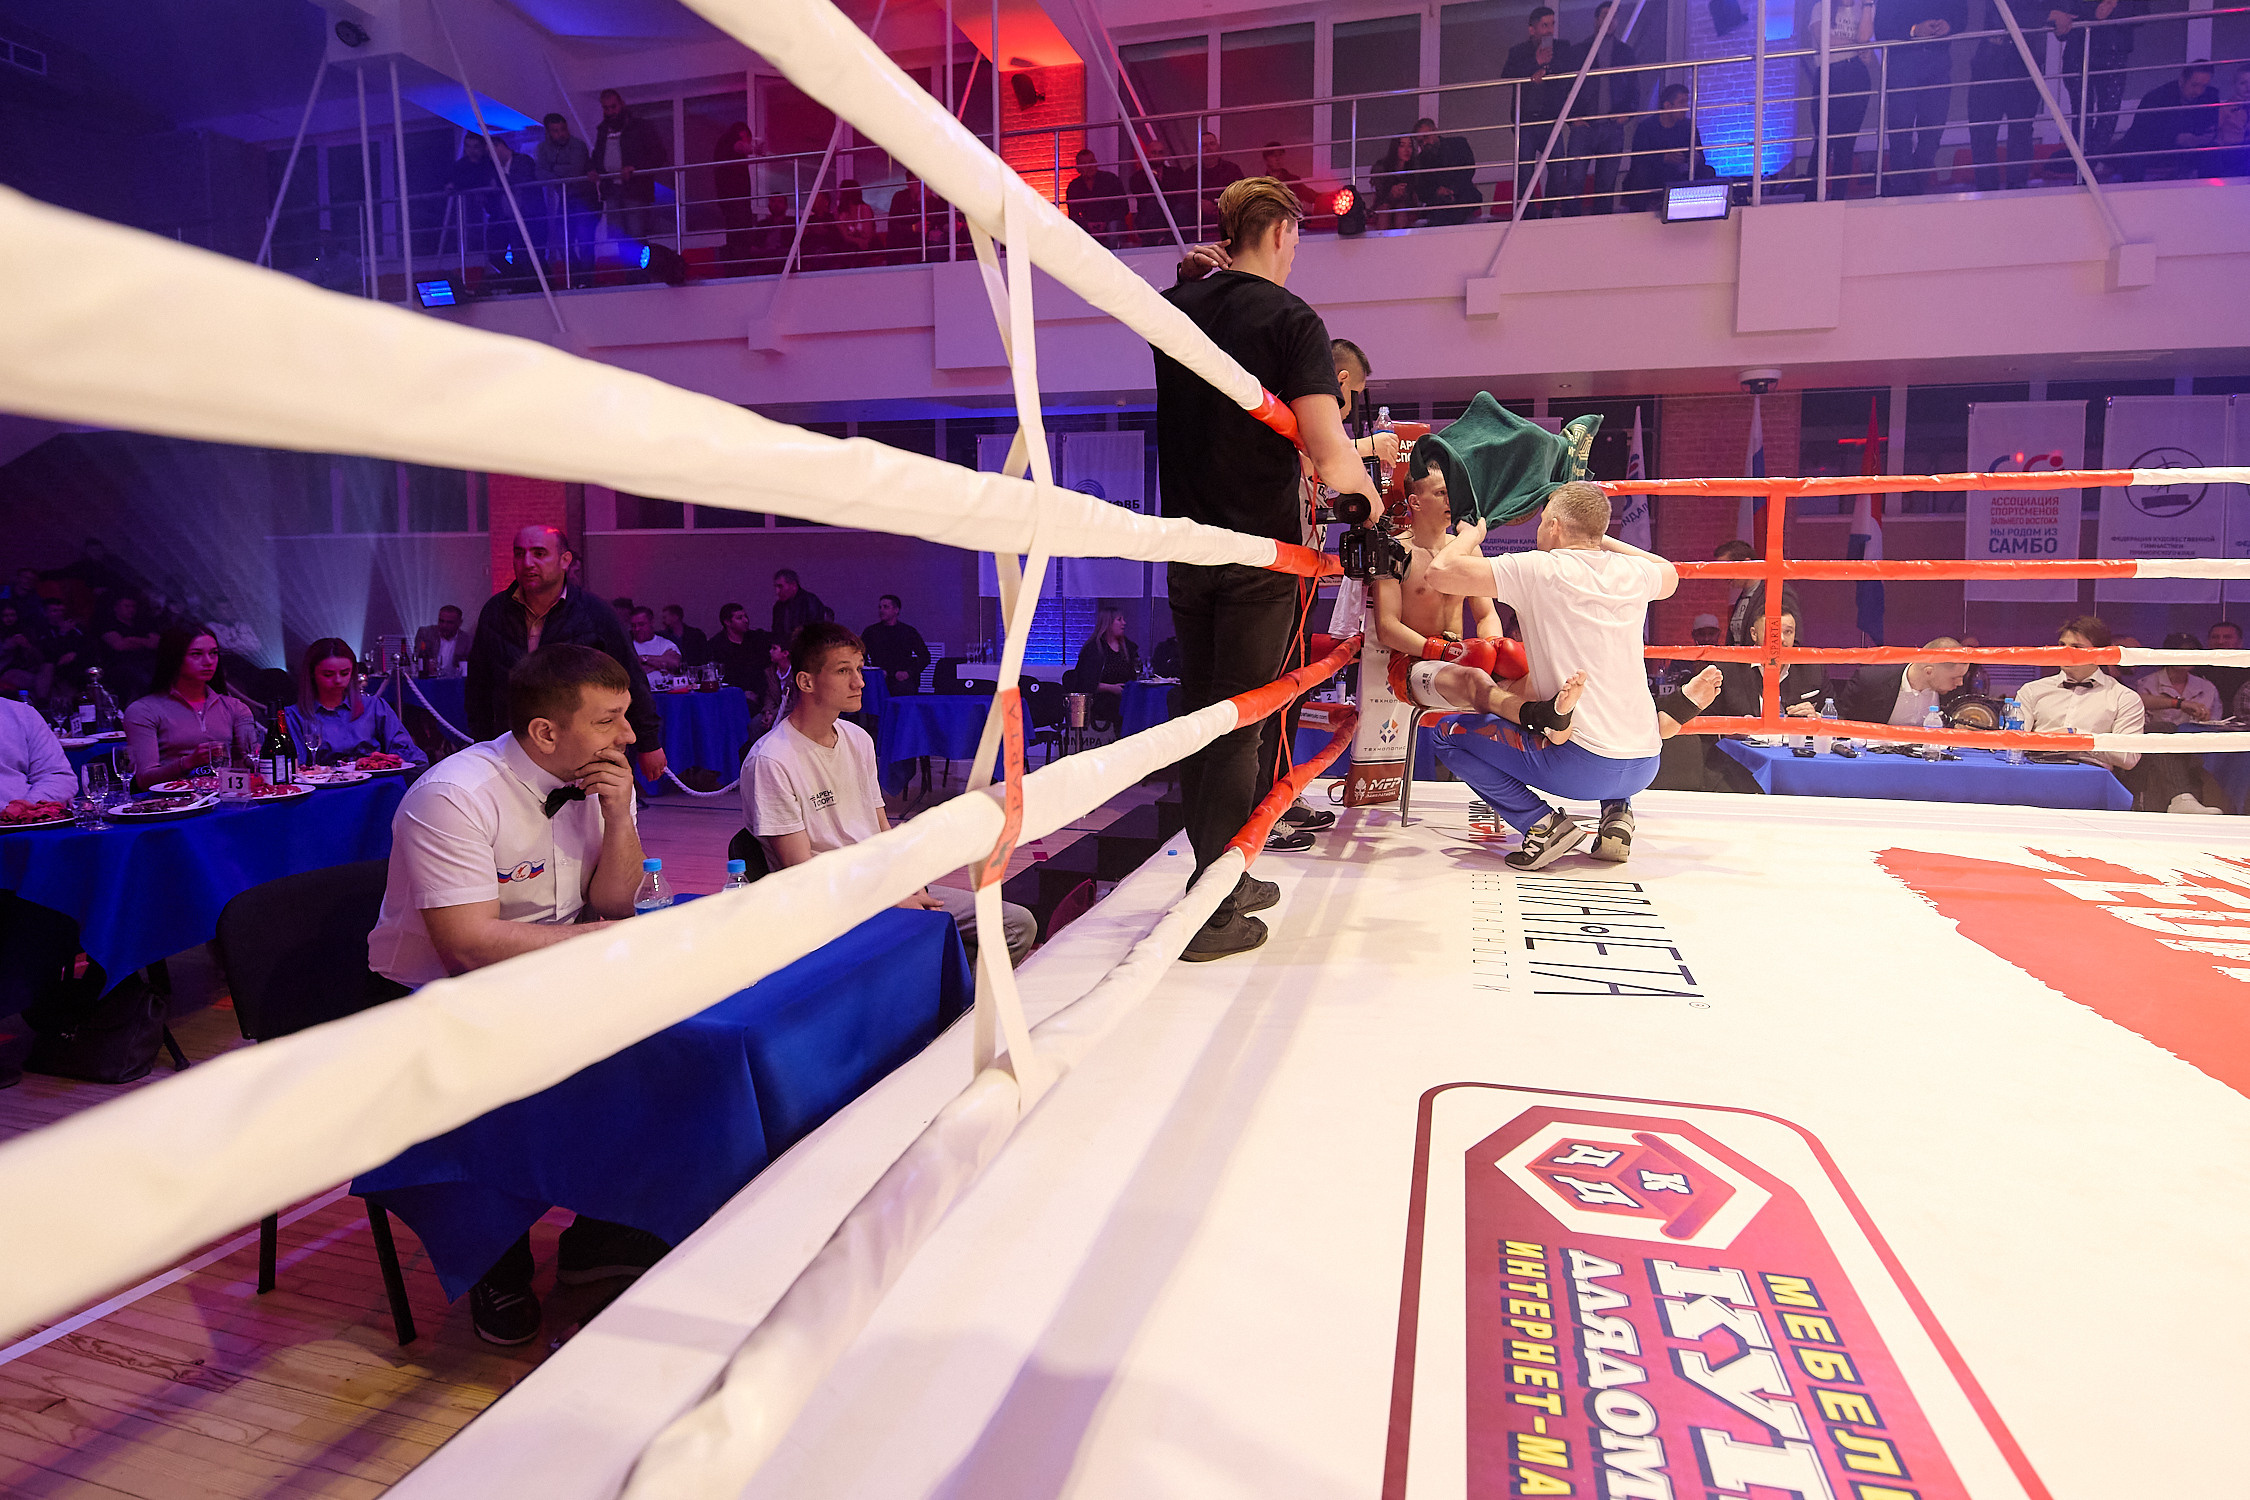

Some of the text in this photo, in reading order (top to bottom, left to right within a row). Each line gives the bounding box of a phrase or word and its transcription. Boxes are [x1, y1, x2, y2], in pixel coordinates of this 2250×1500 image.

[1991, 496, 2059, 506] АССОЦИАЦИЯ
[1990, 507, 2059, 516] СПОРТСМЕНОВ
[1990, 517, 2058, 525] ДАЛЬНЕГО ВОСТОКА
[1990, 527, 2058, 537] МЫ РОДОМ ИЗ
[1989, 537, 2058, 554] САМБО
[227, 775, 244, 790] 13
